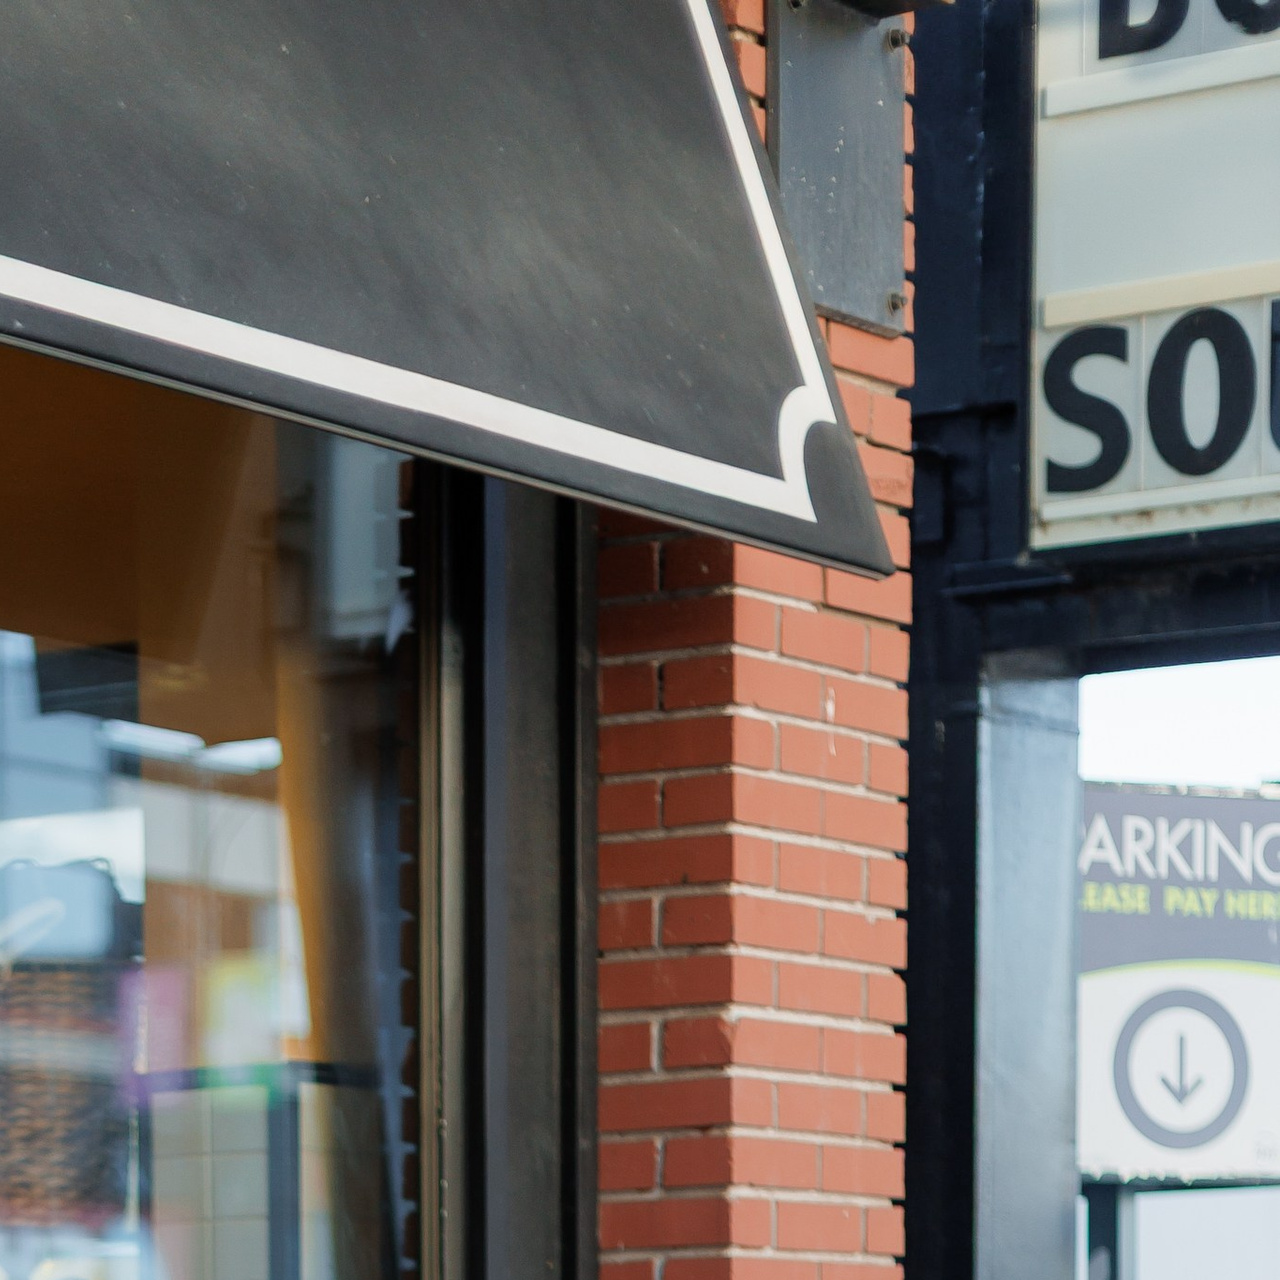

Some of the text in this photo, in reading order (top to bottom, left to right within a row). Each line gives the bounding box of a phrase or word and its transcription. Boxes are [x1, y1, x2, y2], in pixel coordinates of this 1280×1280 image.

[1043, 308, 1280, 493] SO
[1077, 812, 1280, 887] ARKING
[1163, 885, 1218, 918] PAY
[1223, 888, 1280, 921] HER
